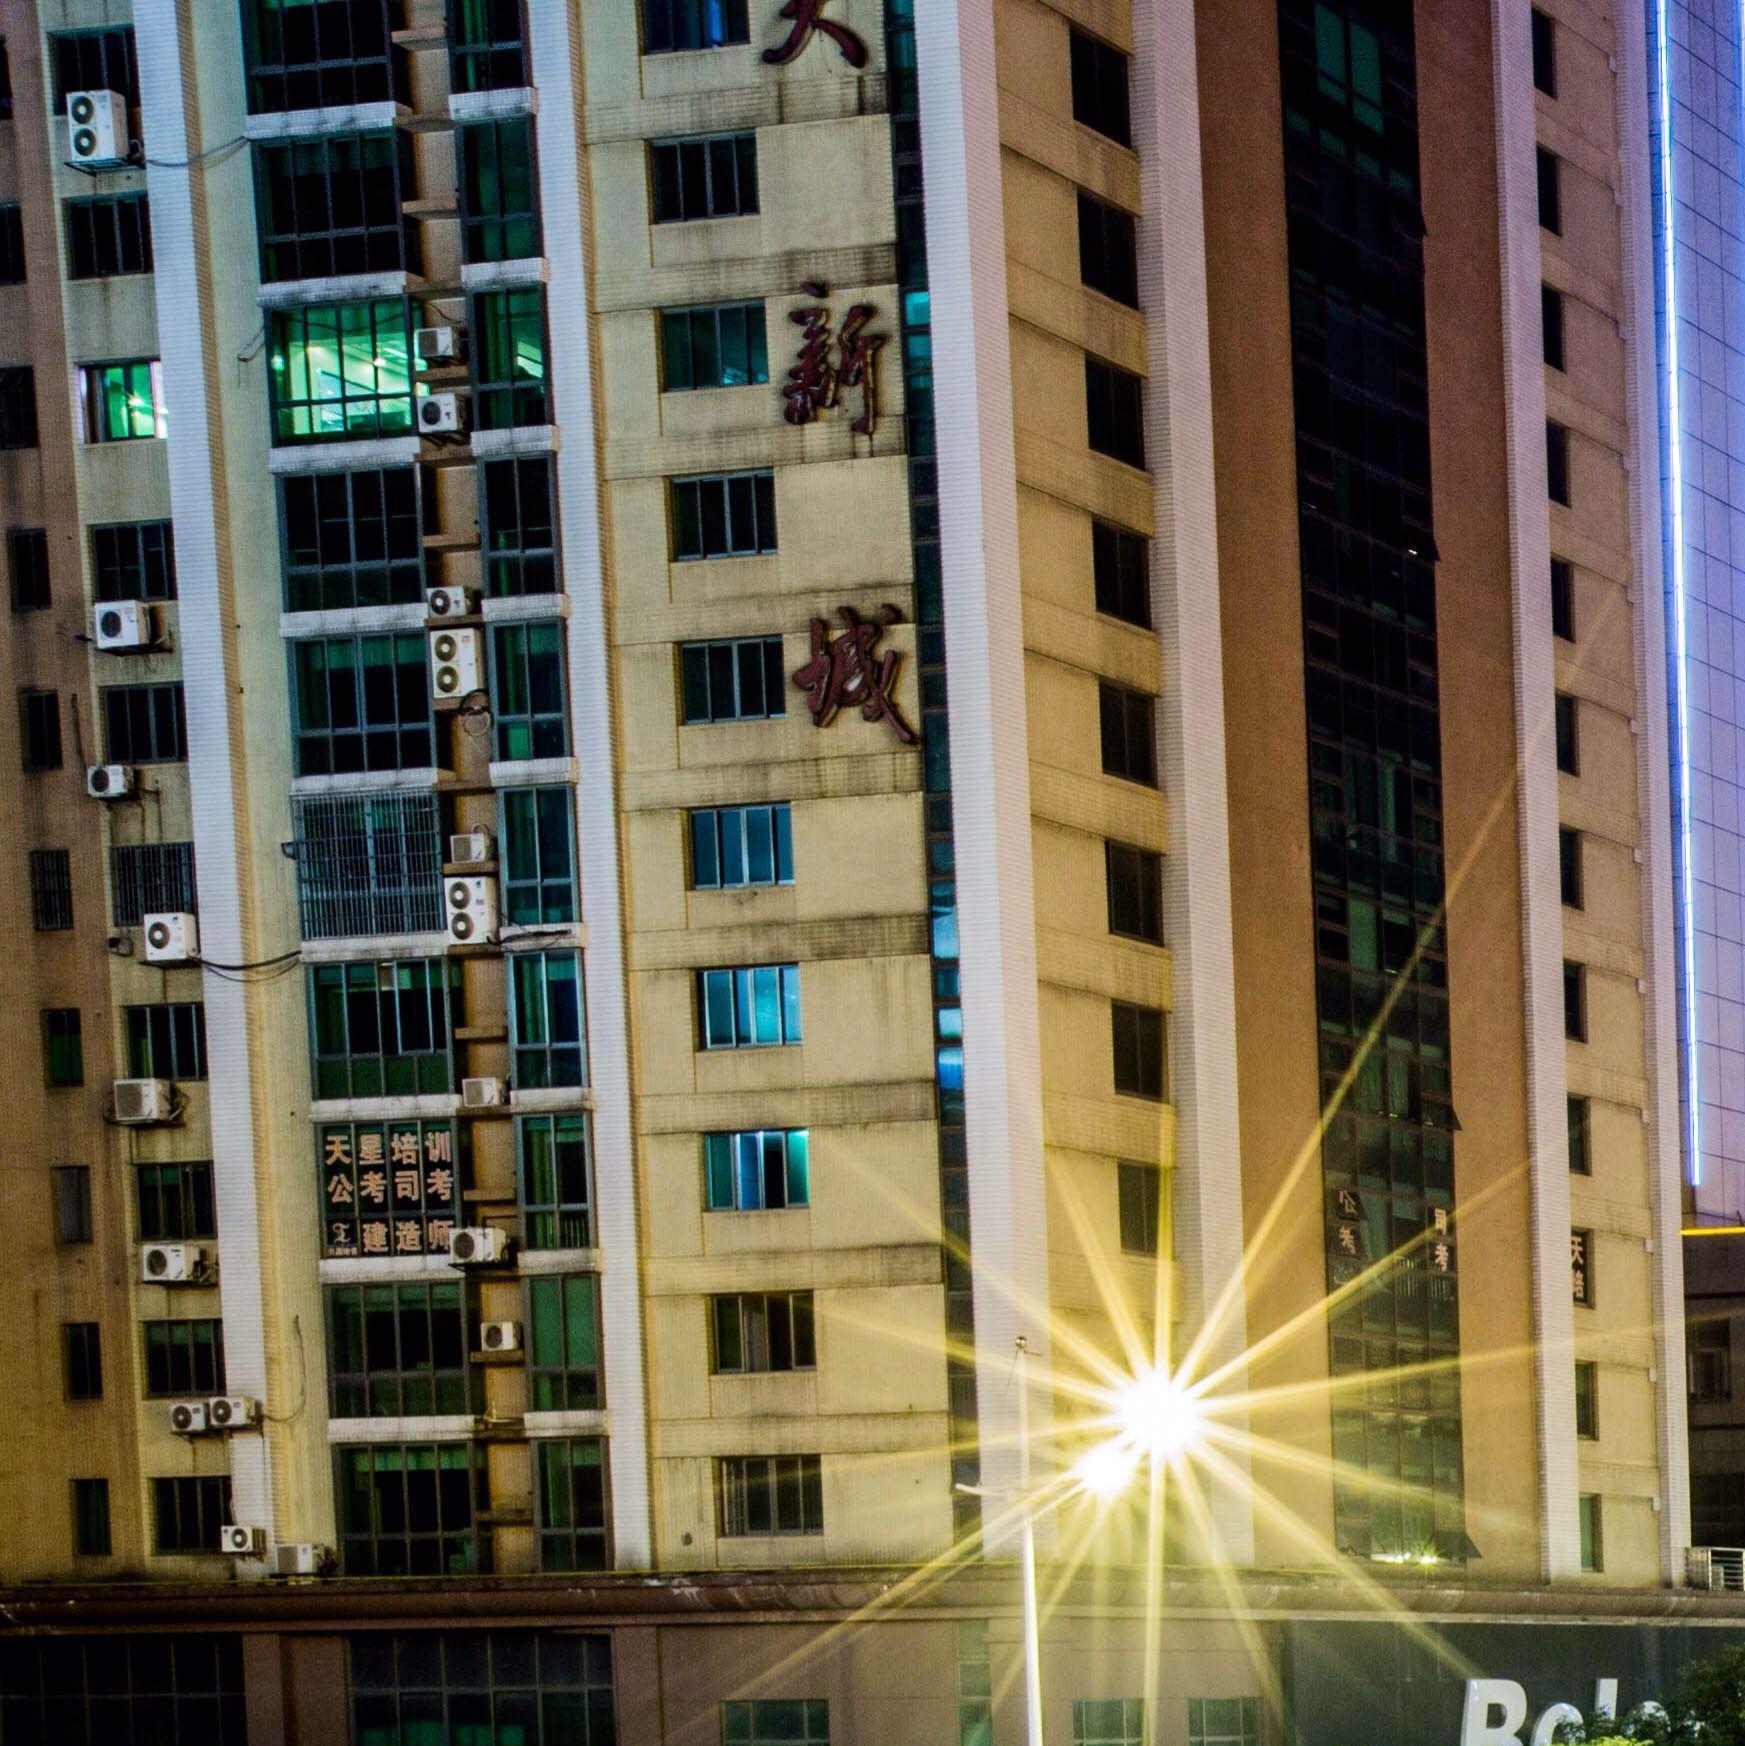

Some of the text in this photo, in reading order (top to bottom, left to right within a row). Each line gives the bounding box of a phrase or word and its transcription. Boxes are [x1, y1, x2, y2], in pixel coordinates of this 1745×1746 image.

[325, 1131, 452, 1166] 天星培训
[362, 1218, 453, 1253] 建造师
